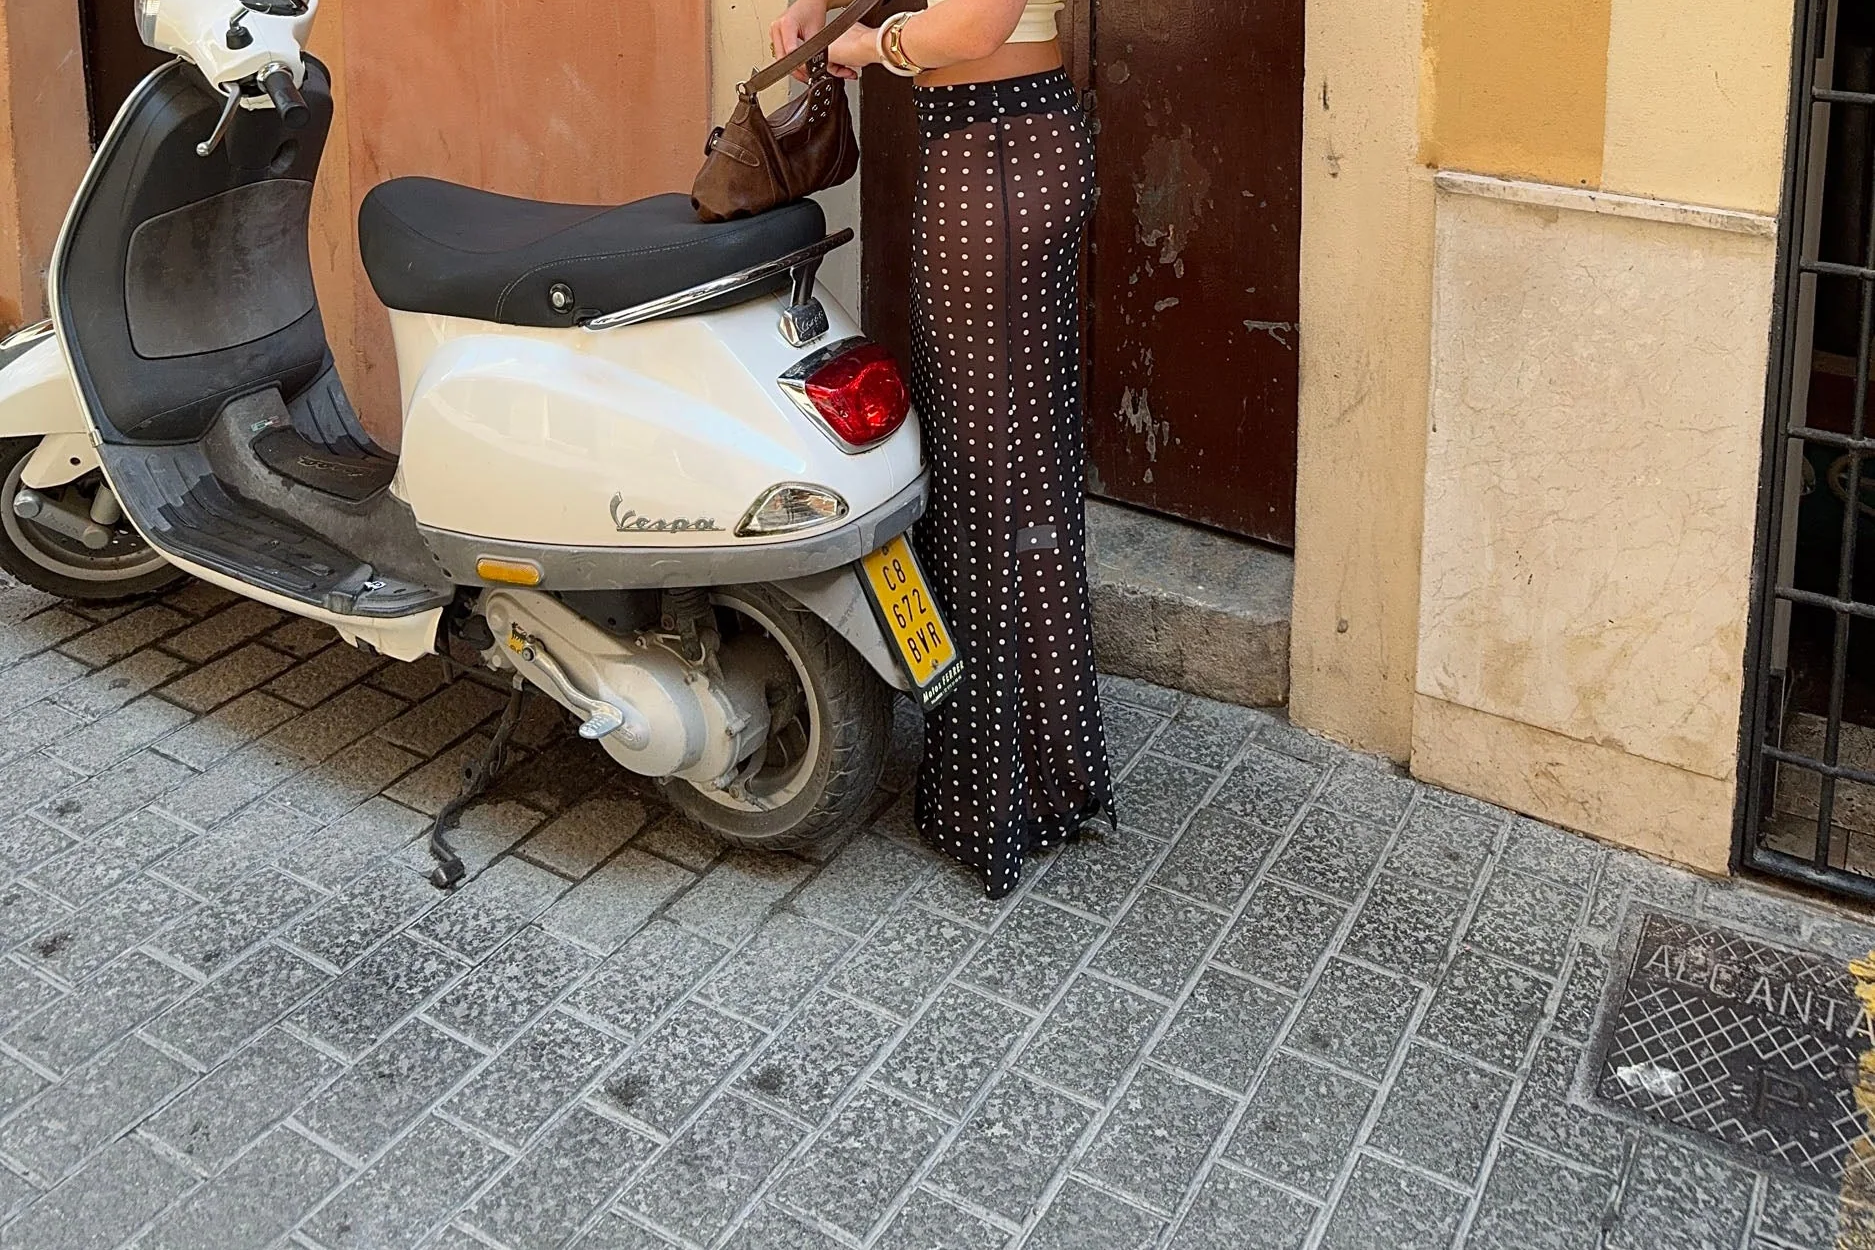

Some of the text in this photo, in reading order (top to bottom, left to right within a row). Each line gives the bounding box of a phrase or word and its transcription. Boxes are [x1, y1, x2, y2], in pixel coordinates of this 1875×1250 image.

[610, 490, 726, 534] Vespa
[882, 558, 906, 591] C8
[892, 588, 927, 629] 672
[907, 621, 942, 664] BVR
[922, 682, 942, 704] Motos
[942, 660, 964, 686] FERRER
